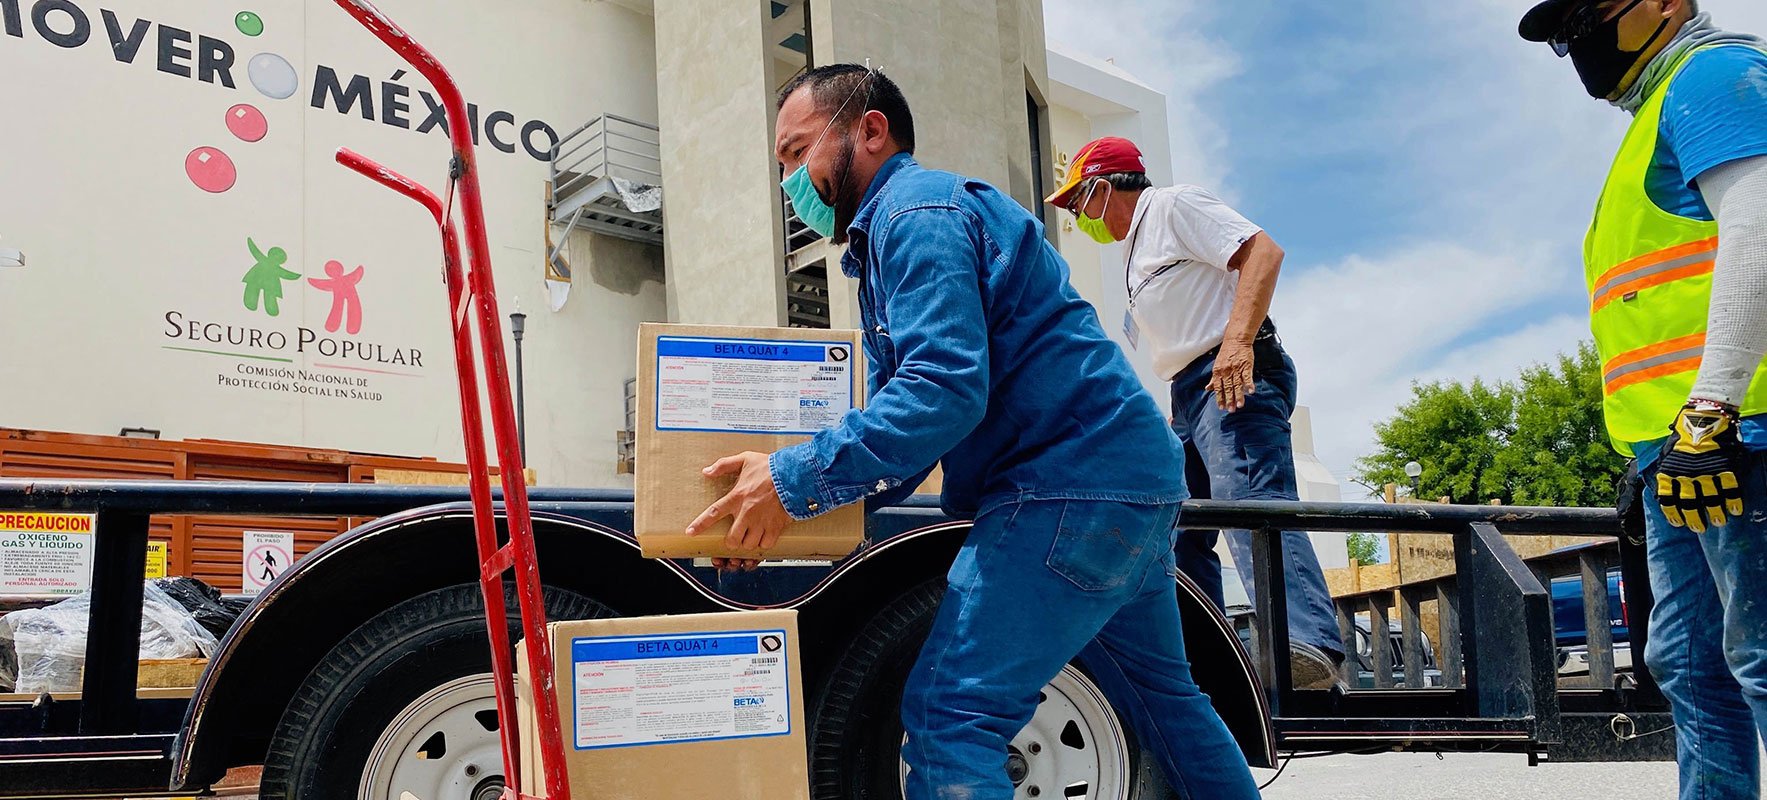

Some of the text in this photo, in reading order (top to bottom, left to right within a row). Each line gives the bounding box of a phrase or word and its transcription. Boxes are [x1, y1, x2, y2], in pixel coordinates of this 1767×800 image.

[310, 64, 561, 162] MÉXICO
[164, 310, 423, 367] SEGURO POPULAR
[714, 344, 789, 356] BETA QUAT 4
[237, 363, 368, 387] COMISIÓN NACIONAL DE
[218, 374, 382, 401] PROTECCIÓN SOCIAL EN SALUD
[800, 399, 821, 407] BETA
[0, 515, 90, 531] PRECAUCION
[637, 639, 718, 653] BETA QUAT 4
[733, 697, 757, 706] BETA
